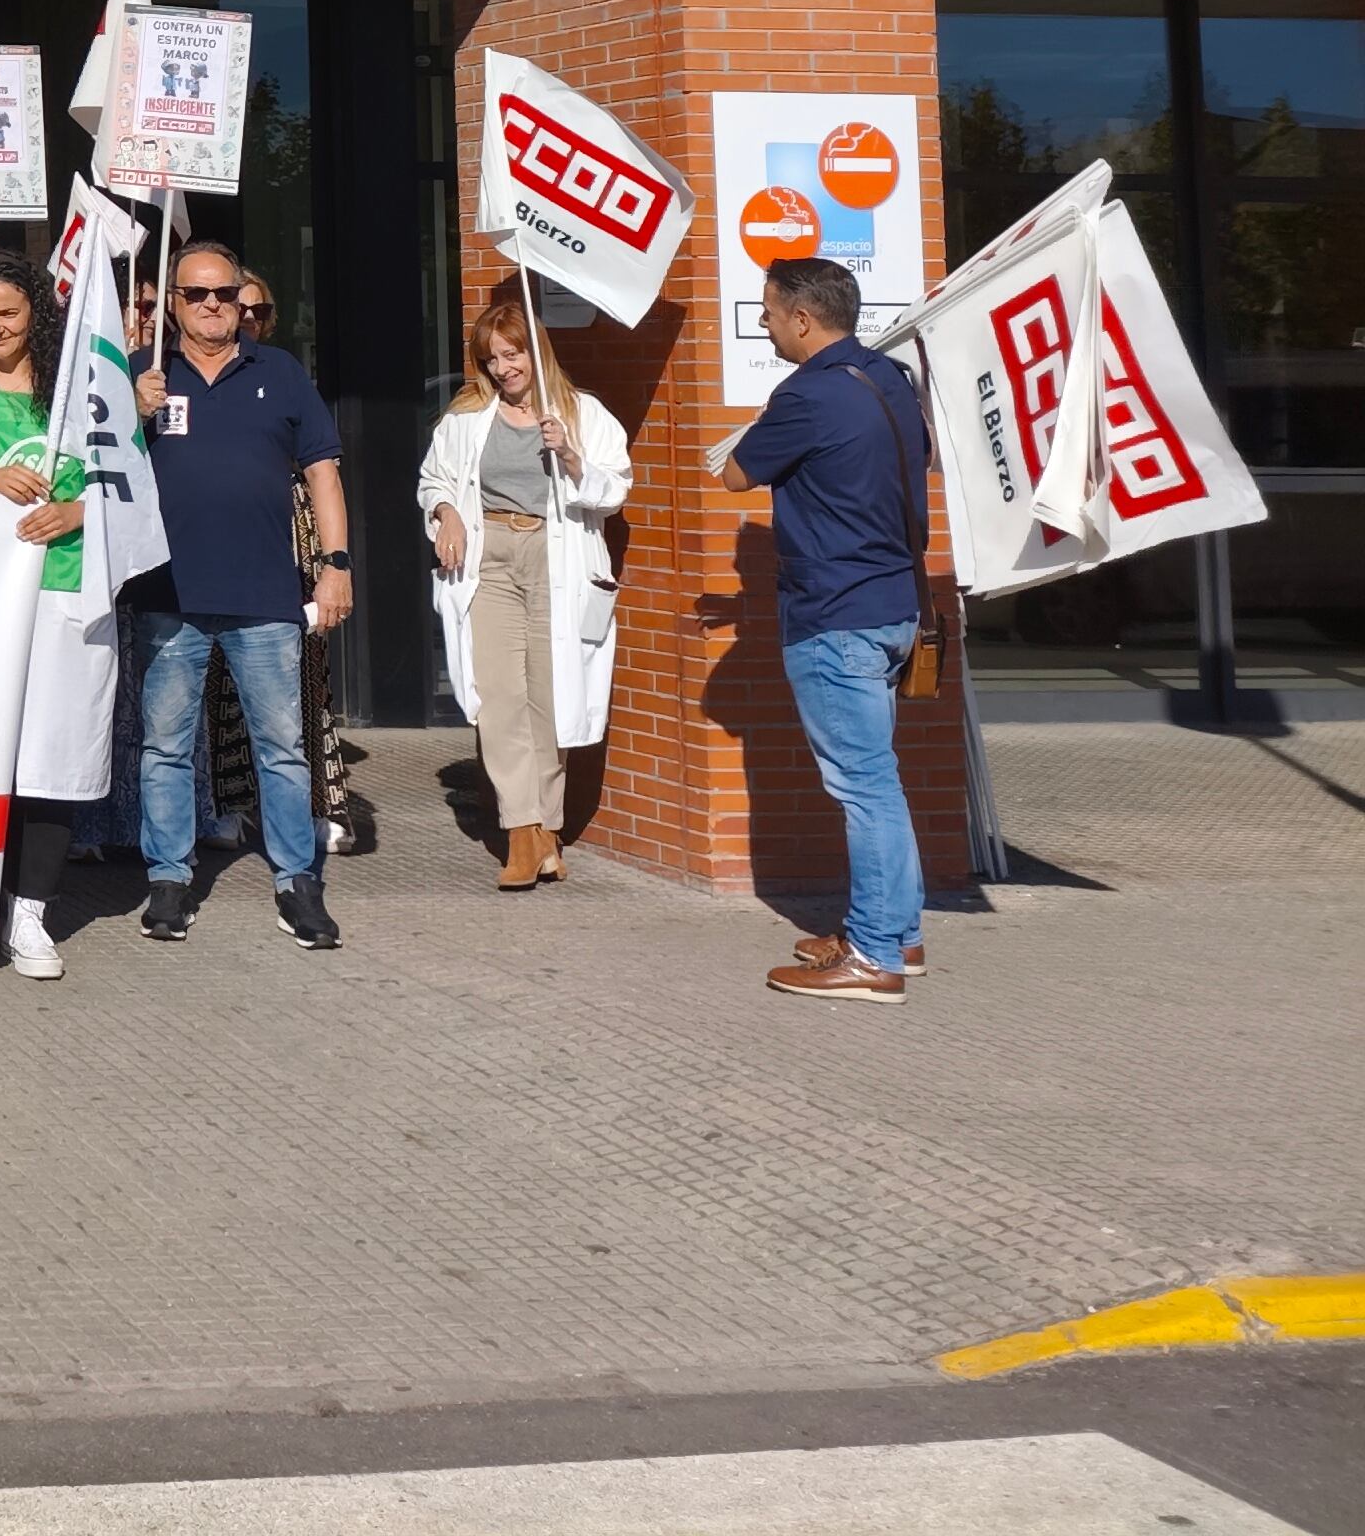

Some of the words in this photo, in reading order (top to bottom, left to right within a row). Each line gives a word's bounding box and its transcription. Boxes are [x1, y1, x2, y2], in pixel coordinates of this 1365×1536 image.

[153, 20, 202, 34] CONTRA
[206, 25, 223, 35] UN
[157, 34, 216, 49] ESTATUTO
[162, 49, 208, 62] MARCO
[144, 97, 216, 116] INSUFICIENTE
[515, 200, 586, 256] Bierzo
[821, 238, 872, 253] espacio
[847, 255, 873, 273] sin
[977, 370, 994, 399] El
[982, 407, 1016, 503] Bierzo
